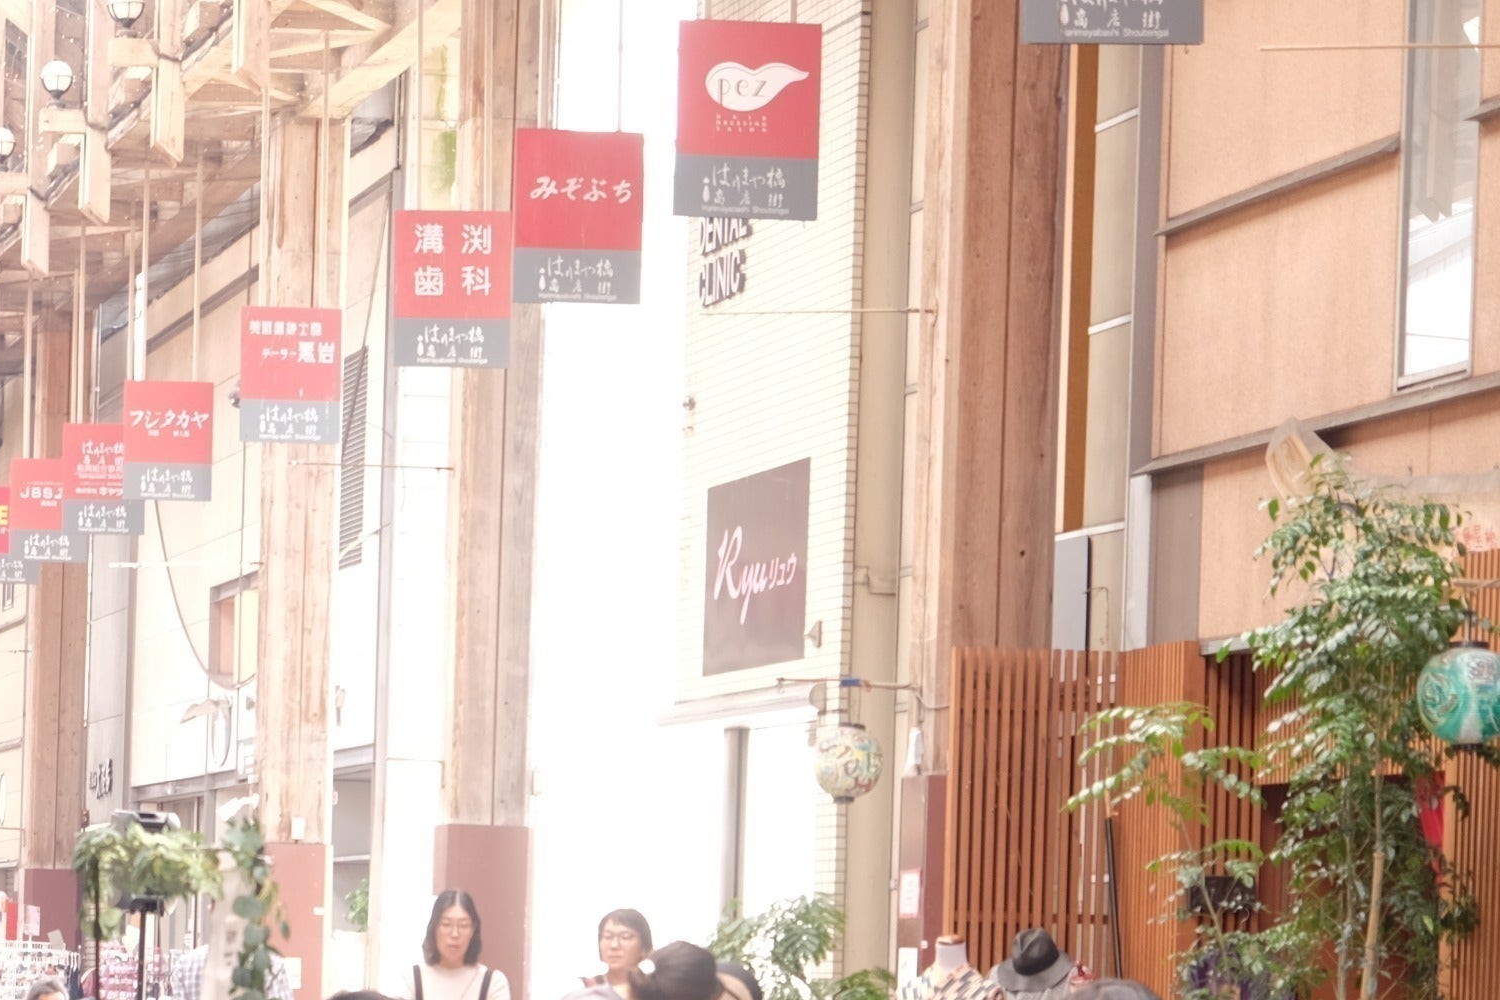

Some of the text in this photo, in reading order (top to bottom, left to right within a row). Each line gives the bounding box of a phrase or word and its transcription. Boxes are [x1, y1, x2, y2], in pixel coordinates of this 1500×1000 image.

[717, 78, 768, 107] pez
[529, 176, 633, 204] みぞぶち
[413, 265, 491, 296] 歯科
[699, 249, 747, 308] CLINIC
[129, 408, 210, 430] フジタカヤ
[713, 525, 767, 625] Ryu
